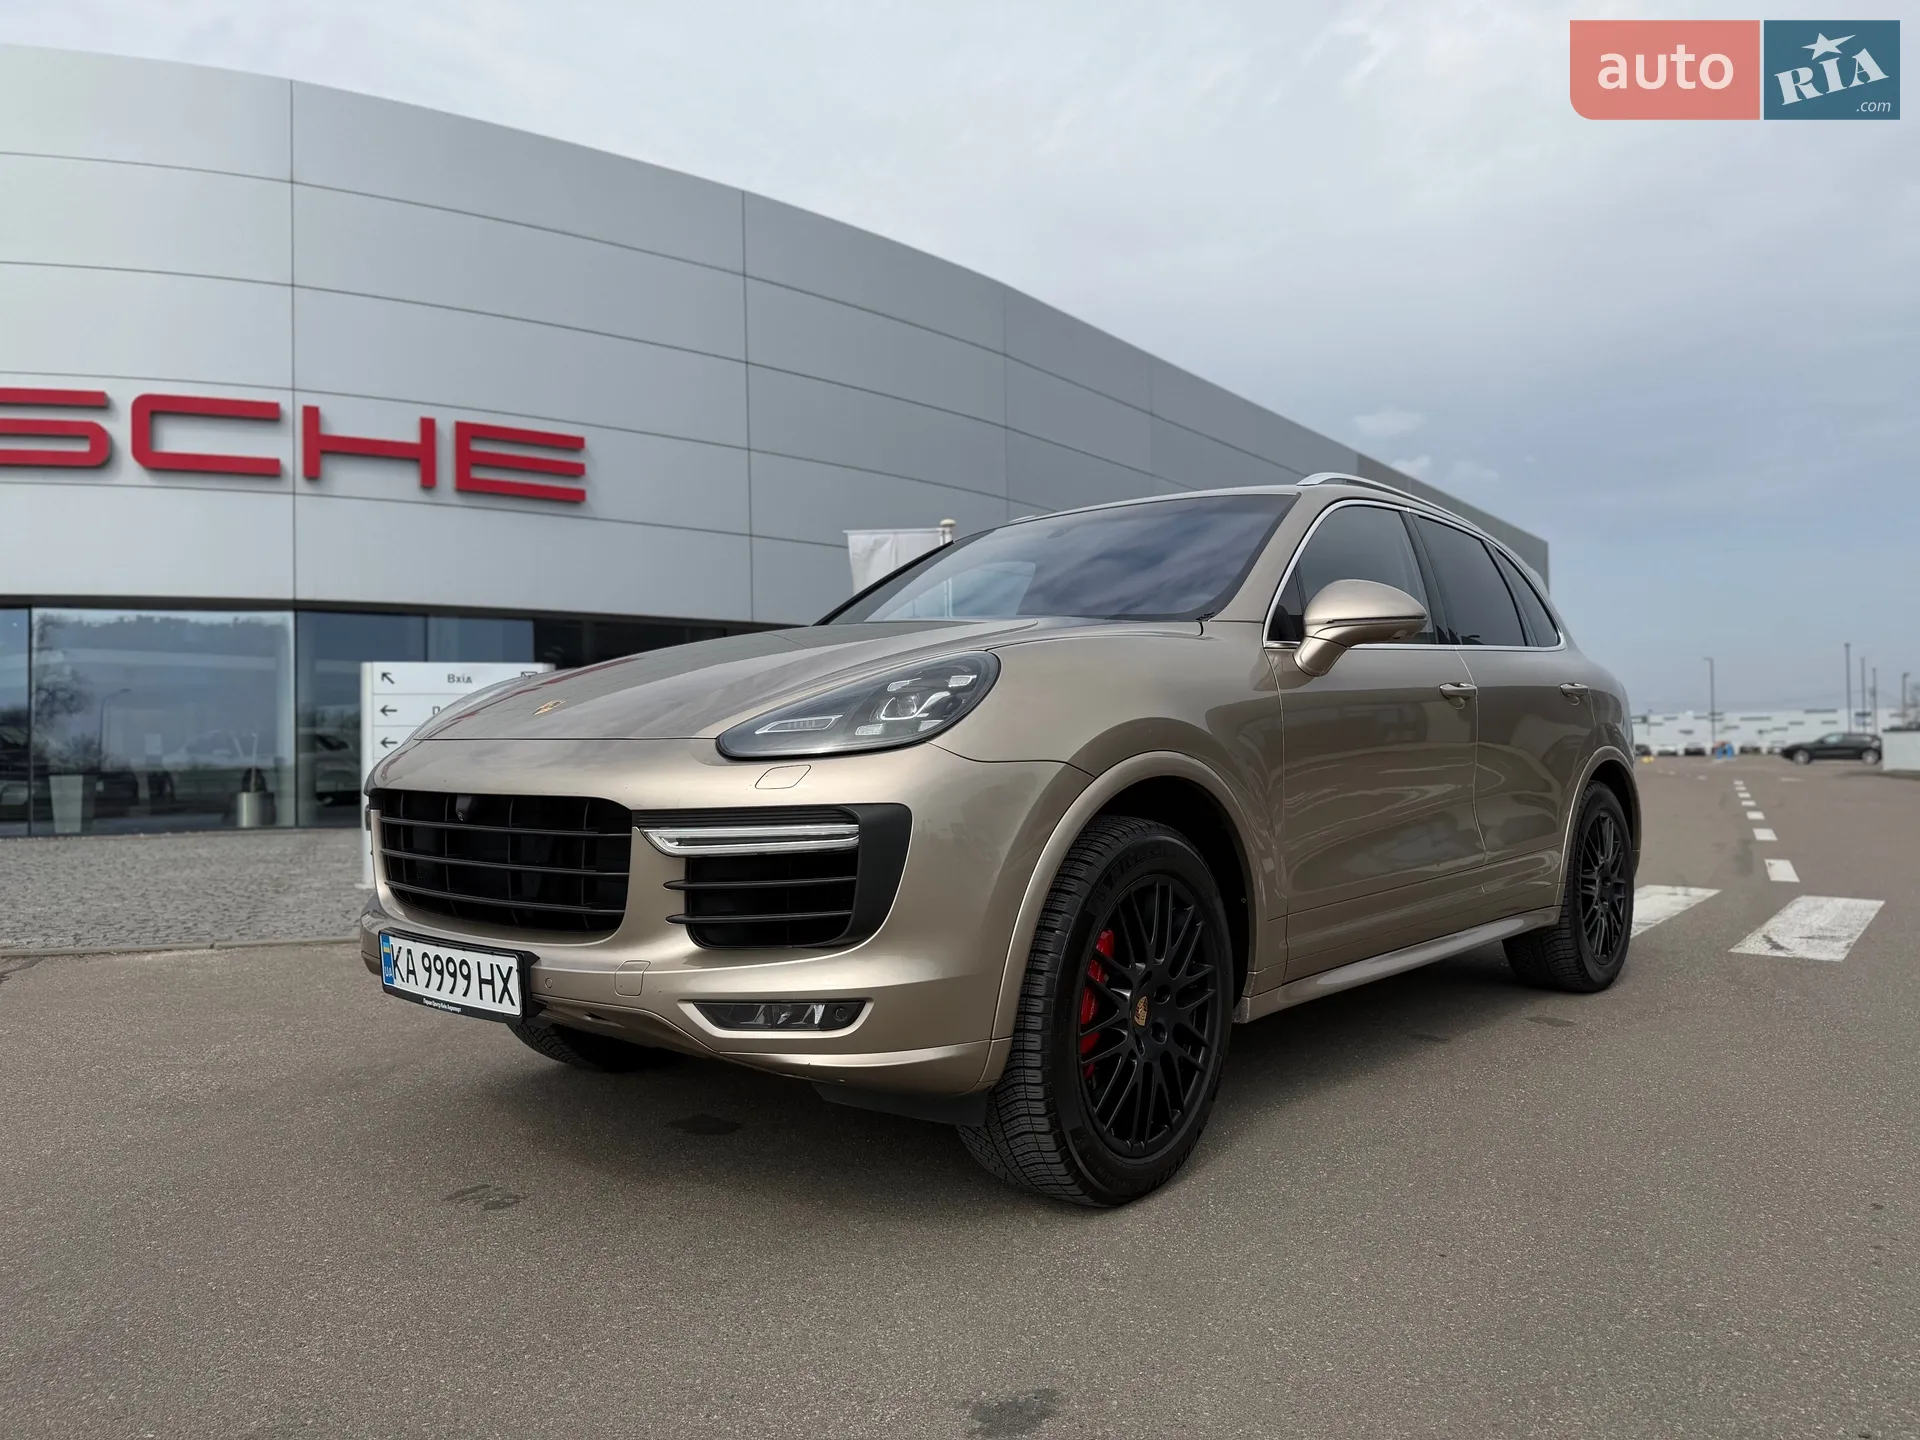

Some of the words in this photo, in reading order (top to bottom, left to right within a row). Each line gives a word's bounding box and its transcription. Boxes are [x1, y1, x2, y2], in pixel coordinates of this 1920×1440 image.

[391, 943, 418, 986] KA
[421, 951, 472, 997] 9999
[476, 961, 516, 1006] HX
